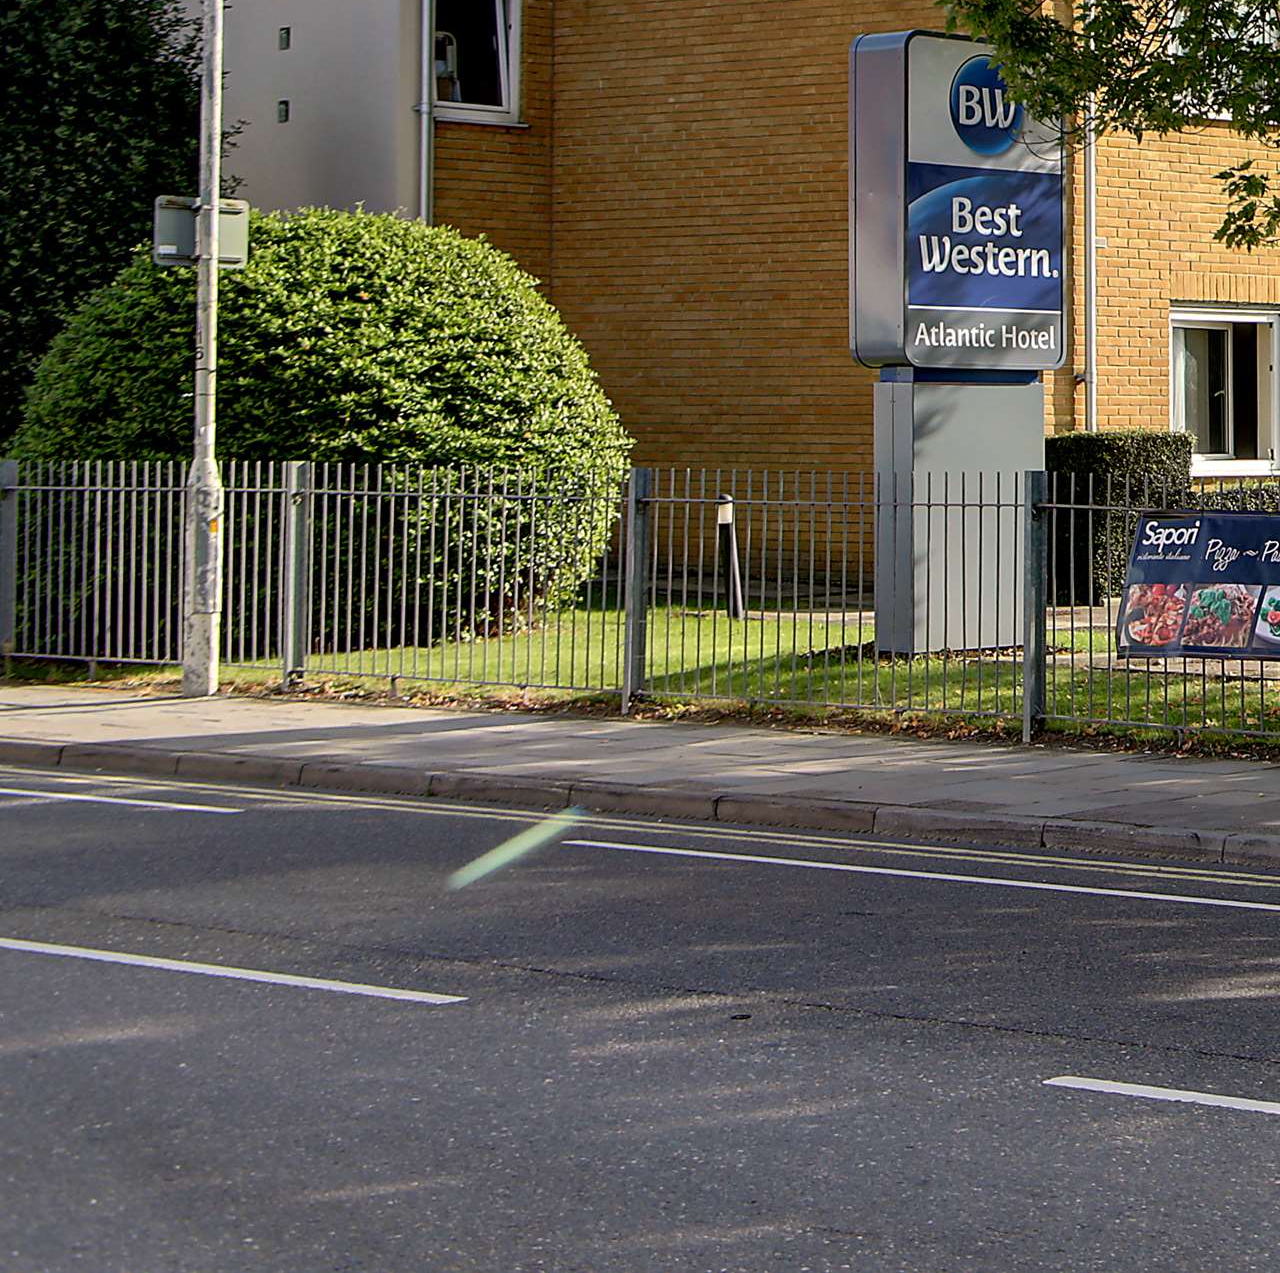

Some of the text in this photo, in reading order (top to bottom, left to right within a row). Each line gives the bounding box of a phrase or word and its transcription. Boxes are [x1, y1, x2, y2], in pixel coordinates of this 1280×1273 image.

[958, 84, 1016, 129] BW
[952, 196, 1023, 238] Best
[914, 322, 1055, 350] Atlantic Hotel
[1142, 520, 1200, 553] Sapori
[1205, 538, 1240, 572] Pizza
